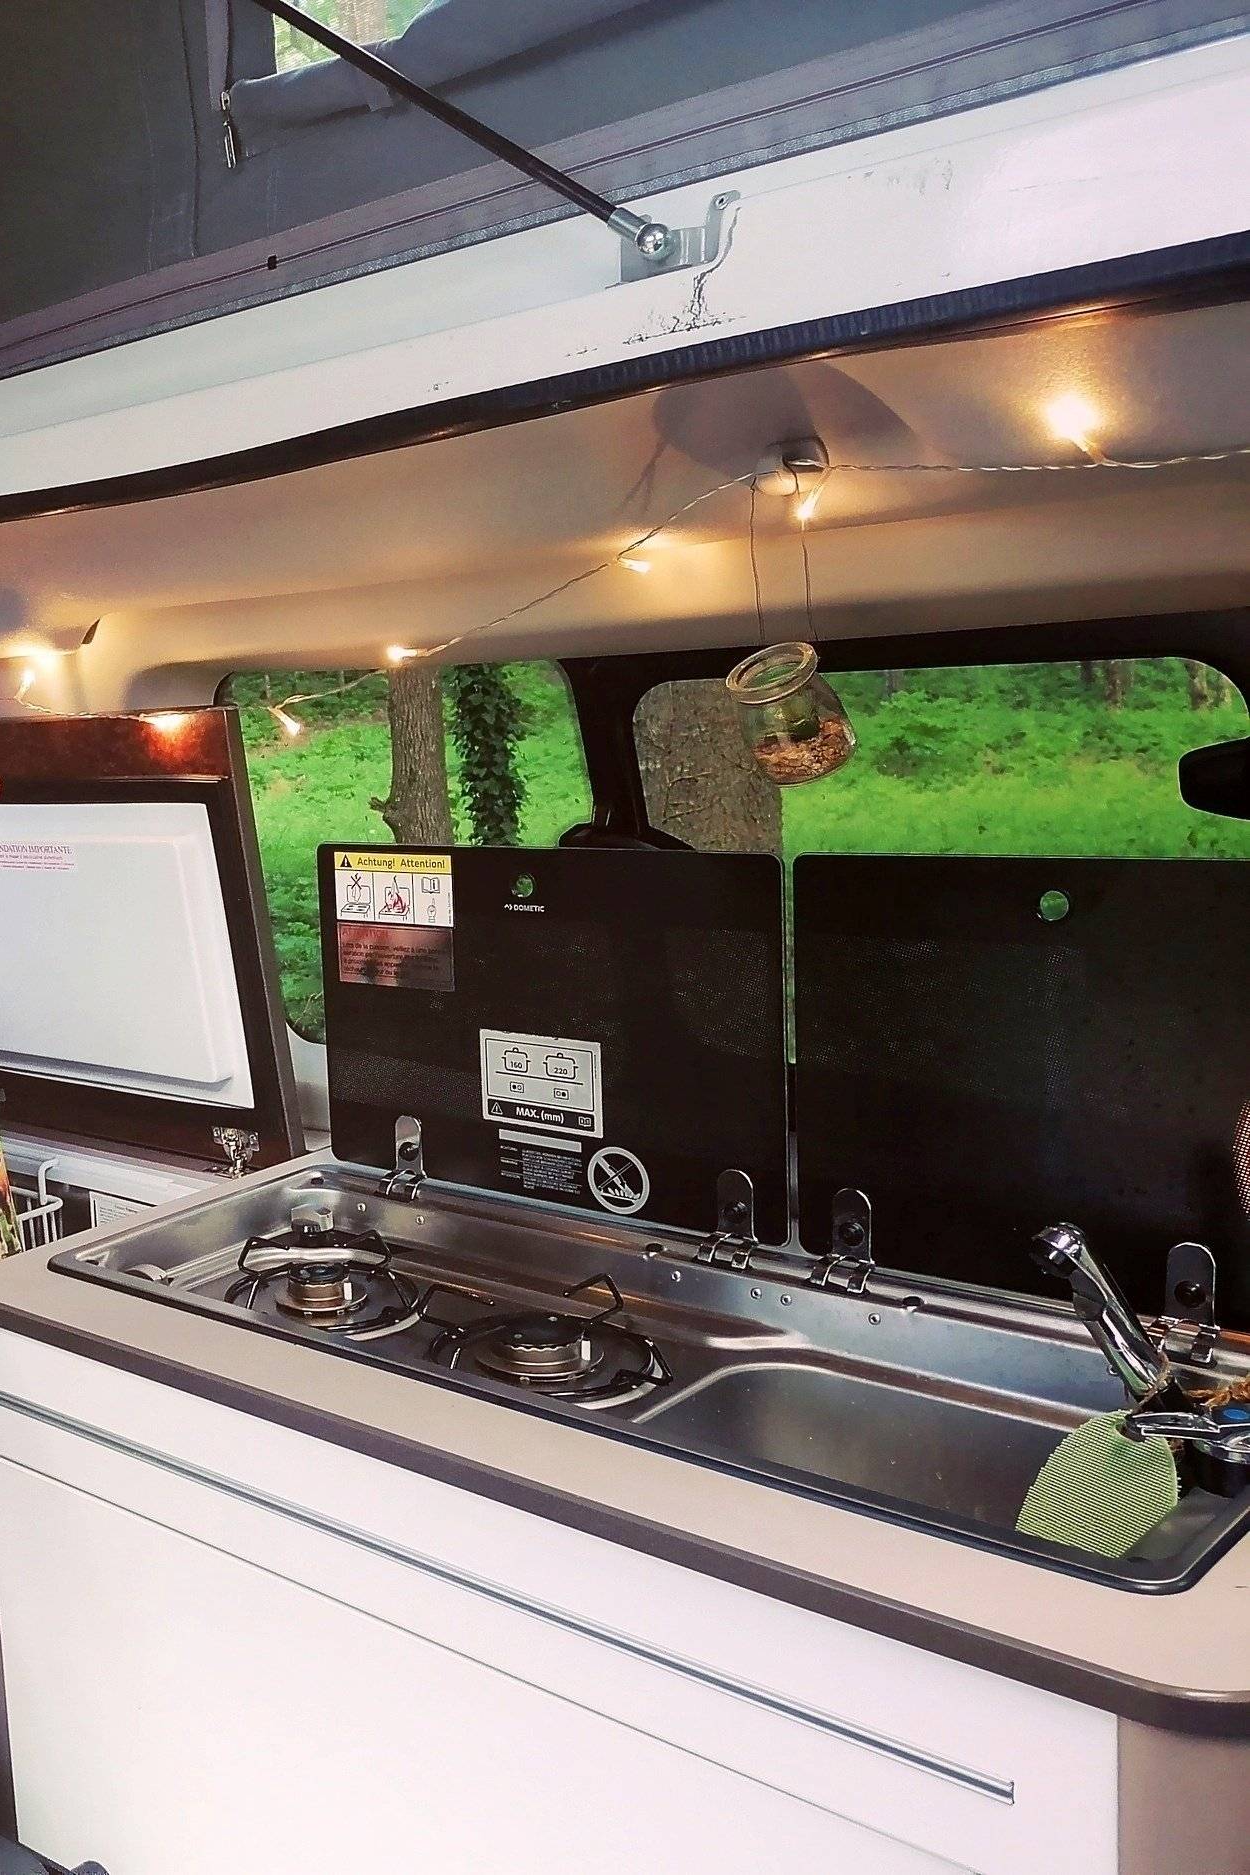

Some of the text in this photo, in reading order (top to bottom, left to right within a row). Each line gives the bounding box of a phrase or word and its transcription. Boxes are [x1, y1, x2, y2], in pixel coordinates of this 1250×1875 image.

[357, 857, 445, 869] Achtung! Attention!
[513, 904, 545, 913] DOMETIC
[510, 1061, 523, 1069] 160
[554, 1067, 568, 1075] 220
[516, 1106, 564, 1124] MAX. (mm)
